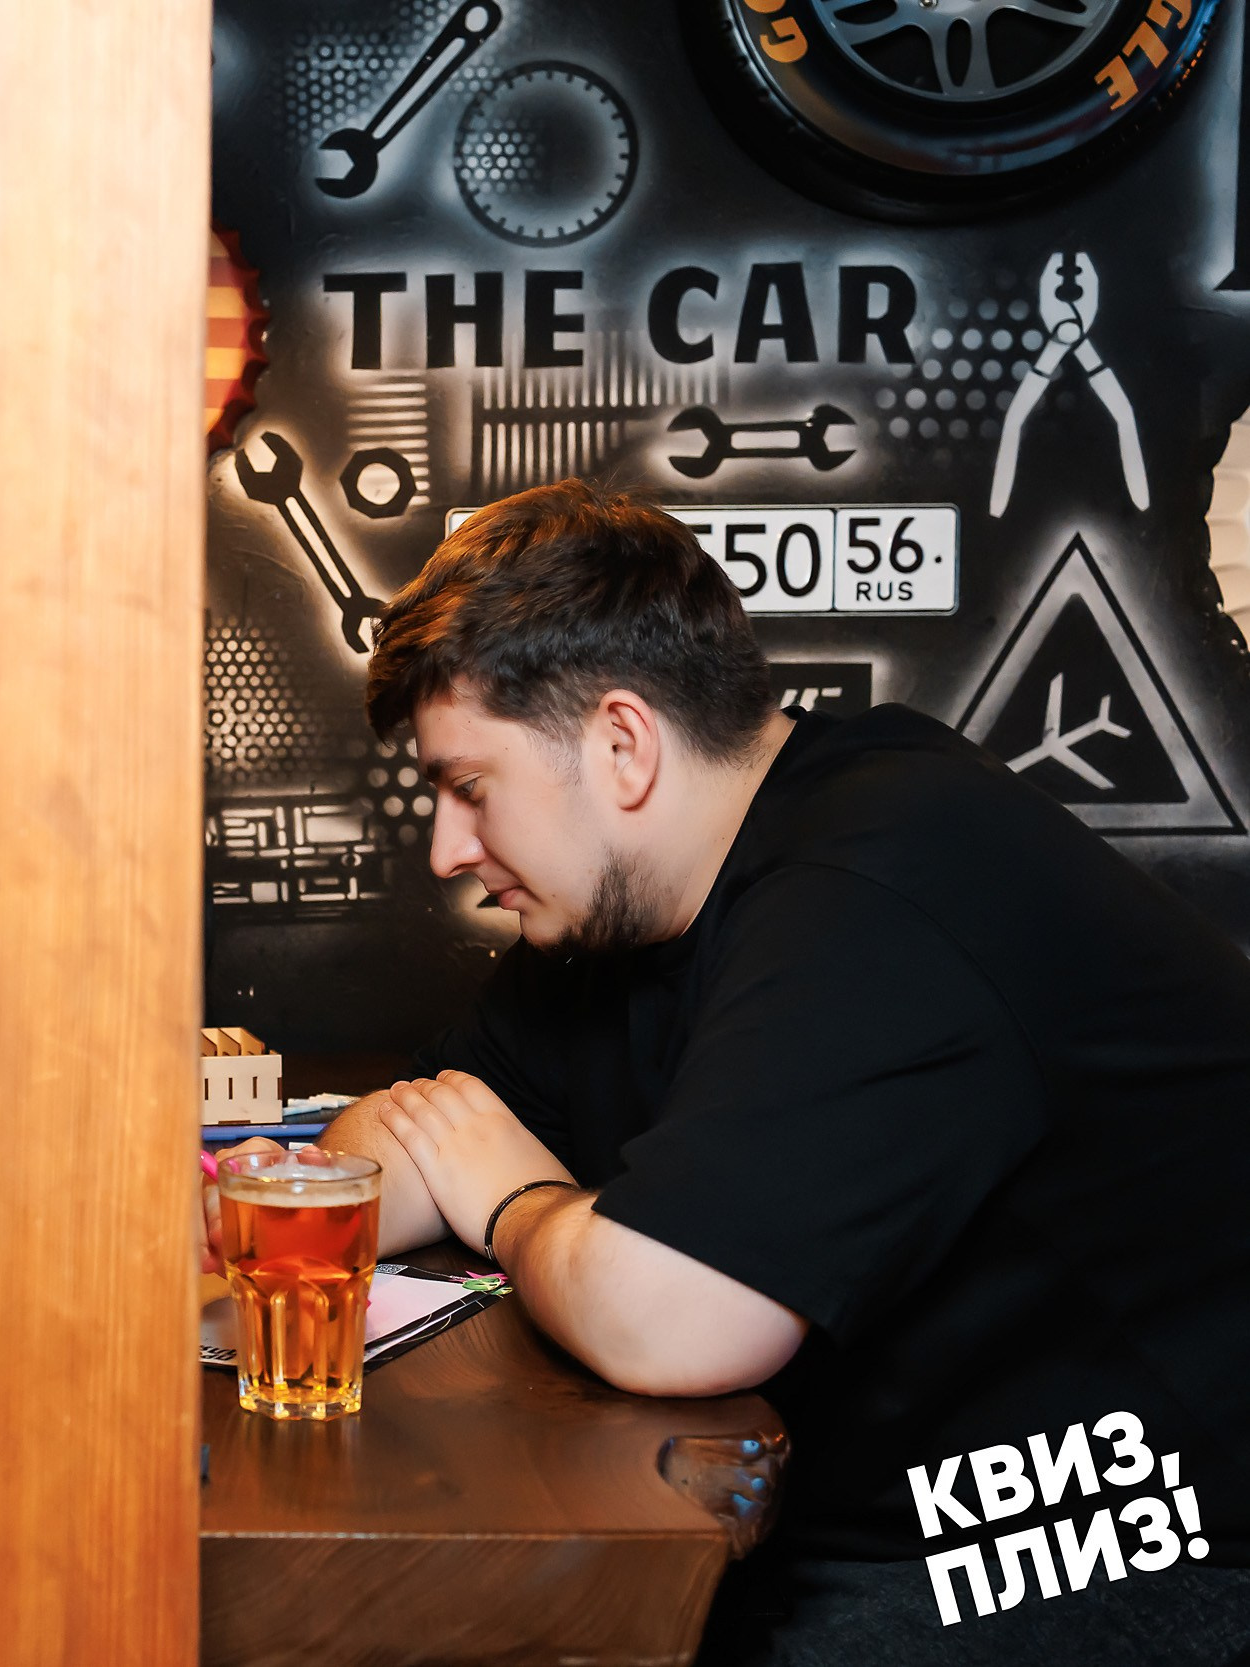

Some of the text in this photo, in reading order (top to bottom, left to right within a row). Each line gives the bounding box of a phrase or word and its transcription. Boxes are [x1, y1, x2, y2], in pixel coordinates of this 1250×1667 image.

[323, 262, 916, 369] THE CAR
[688, 523, 821, 597] 50
[856, 581, 913, 601] RUS
